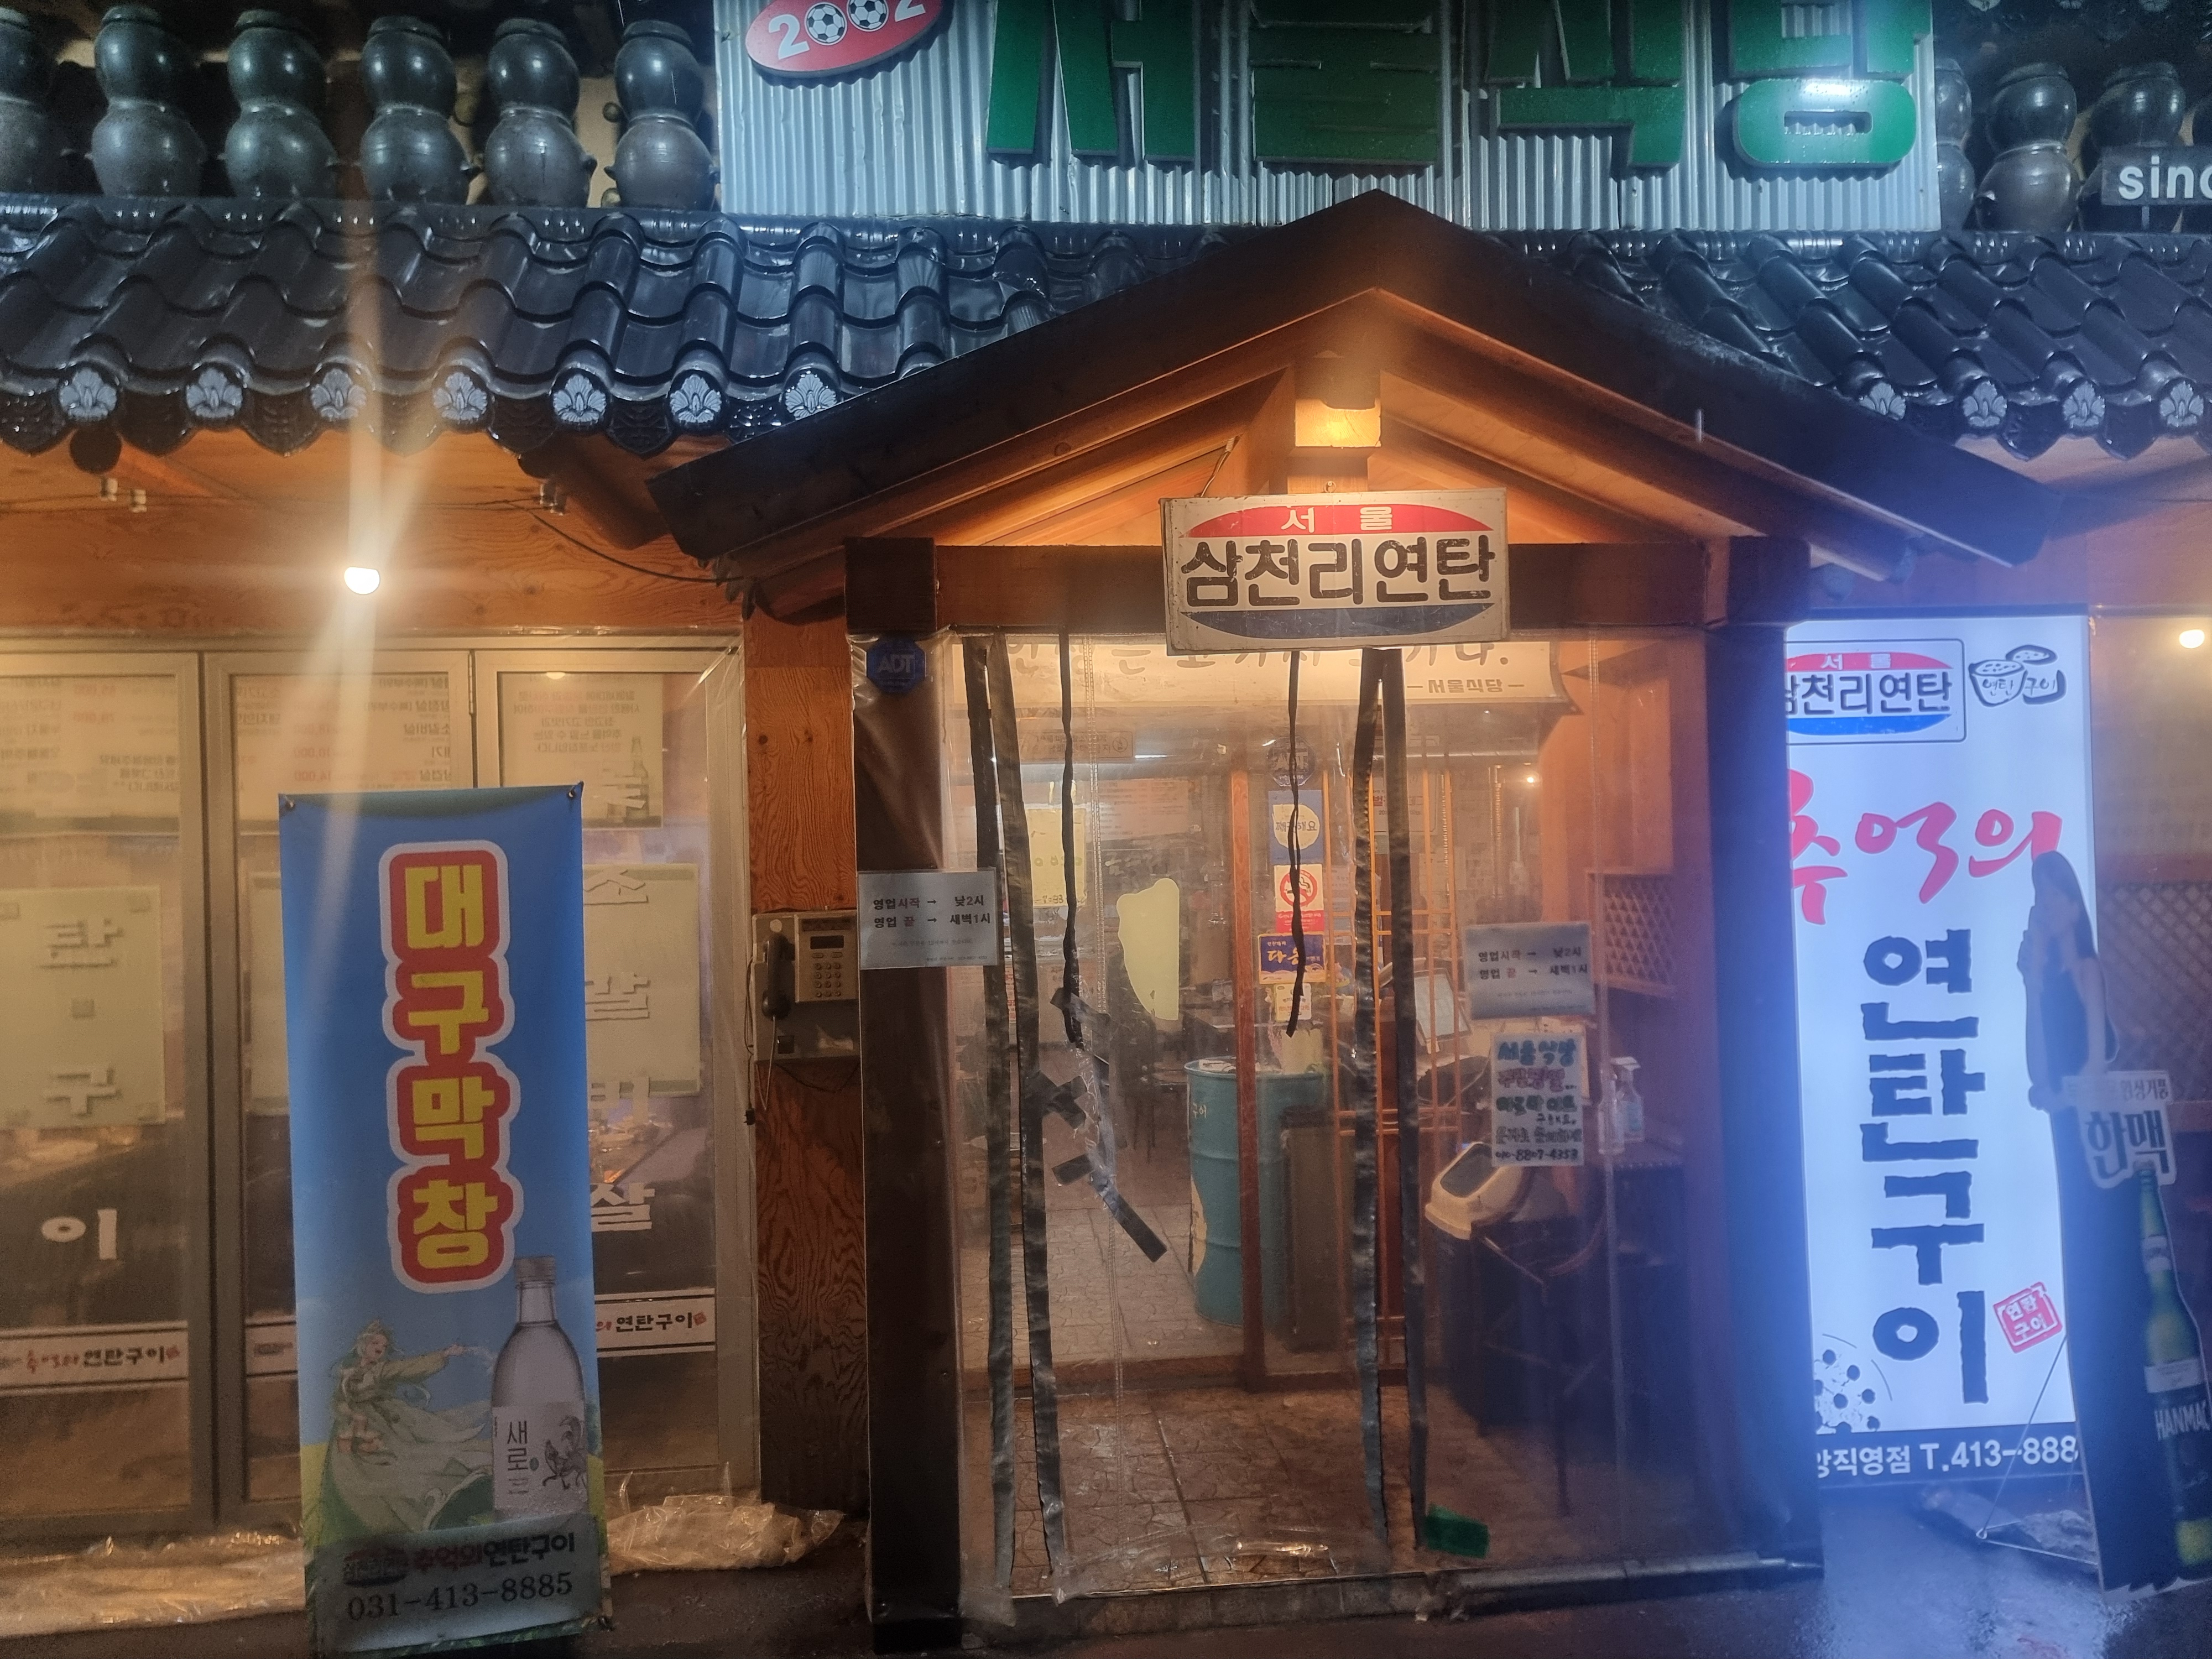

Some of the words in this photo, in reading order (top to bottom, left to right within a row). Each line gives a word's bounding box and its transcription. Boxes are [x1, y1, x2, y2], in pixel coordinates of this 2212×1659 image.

[1281, 505, 1393, 533] 서울
[1180, 534, 1496, 607] 삼천리연탄
[877, 654, 915, 673] ADT
[1428, 679, 1503, 693] 서울식당
[873, 897, 921, 910] 영업시작
[954, 895, 984, 907] 낮2시
[874, 916, 897, 928] 영업
[903, 916, 915, 927] 끝
[950, 912, 991, 926] 새벽1시
[405, 864, 498, 1270] 대구막창
[2085, 1110, 2171, 1180] 한맥
[1860, 928, 1989, 1405] 연탄구이
[615, 1312, 692, 1333] 연탄구이
[83, 1345, 165, 1368] 연탄구이
[507, 1420, 529, 1471] 새로
[483, 1532, 576, 1568] 연탄구이
[347, 1571, 573, 1621] 031-413-8885
